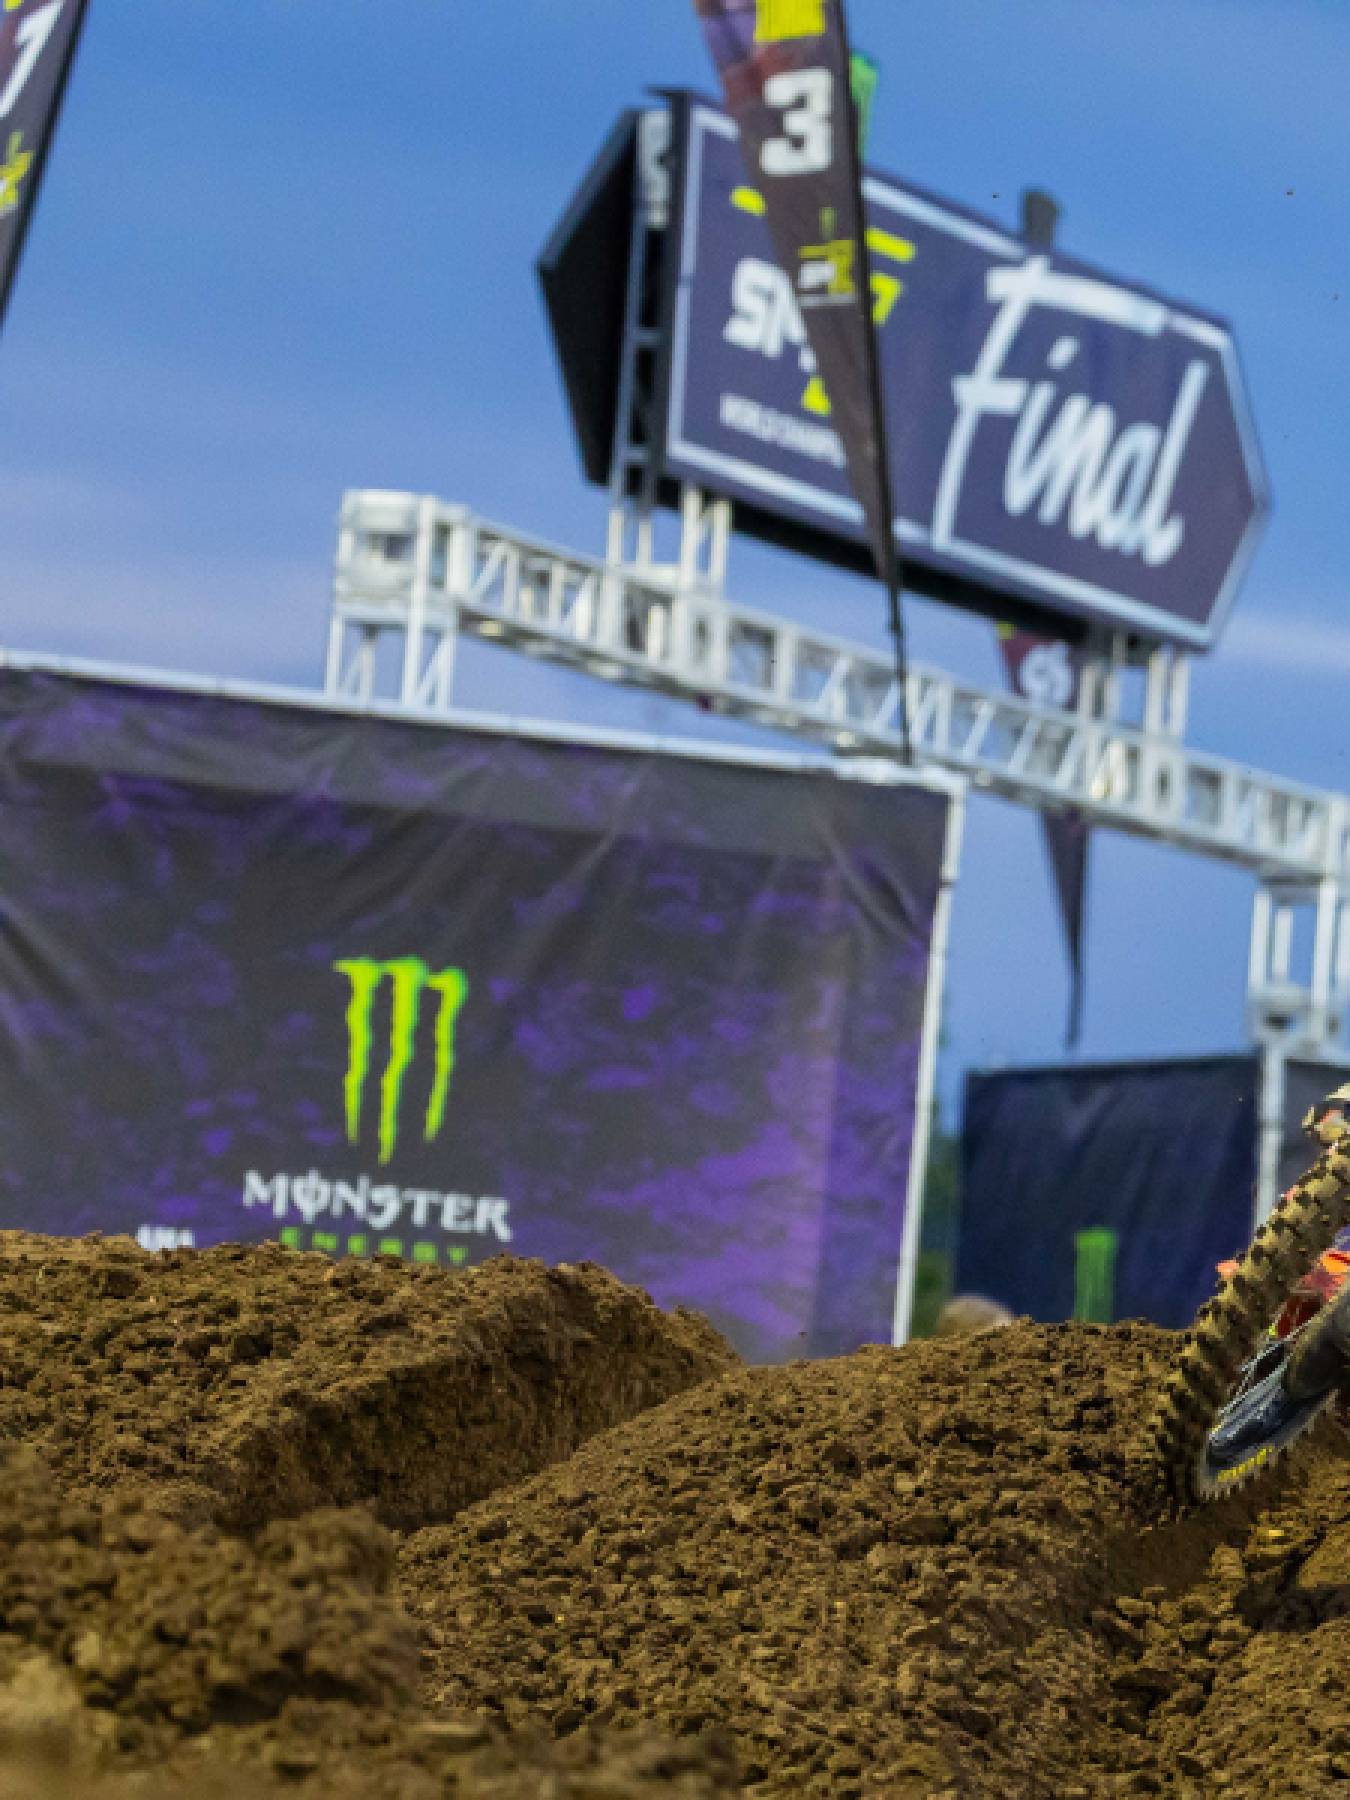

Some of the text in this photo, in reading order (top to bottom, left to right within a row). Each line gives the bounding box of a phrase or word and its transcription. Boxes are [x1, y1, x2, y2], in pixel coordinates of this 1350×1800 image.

[759, 68, 834, 176] 3
[935, 256, 1209, 567] Final
[243, 1169, 513, 1245] MONSTER
